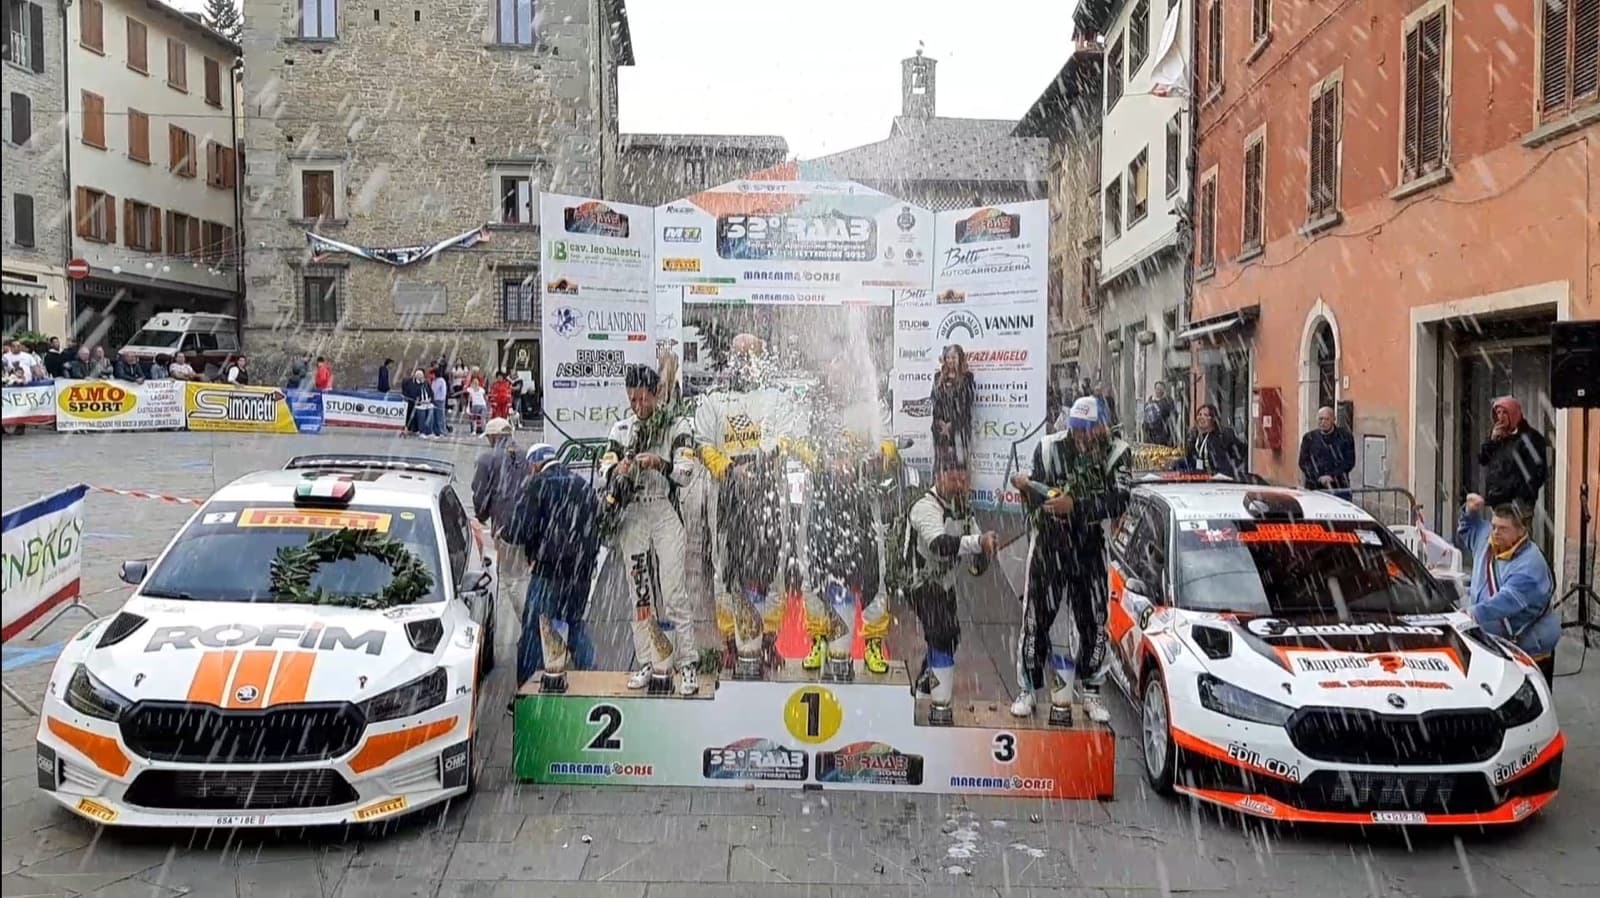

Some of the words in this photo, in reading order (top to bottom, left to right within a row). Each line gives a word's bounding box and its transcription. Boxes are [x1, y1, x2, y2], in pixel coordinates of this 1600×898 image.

[590, 244, 605, 254] leo
[940, 264, 1032, 277] AUTOCARROZZERIA
[587, 310, 647, 332] CALANDRINI
[984, 314, 1034, 331] VANNINI
[576, 349, 625, 362] BRUSORI
[988, 350, 1028, 361] ANGELO
[68, 386, 126, 401] AMO
[973, 381, 1028, 391] annerini
[69, 402, 124, 412] SPORT
[188, 390, 278, 421] Simonetti
[325, 400, 365, 412] STUDIO
[367, 405, 405, 417] COLOR
[800, 692, 820, 737] 1
[588, 704, 622, 750] 2
[994, 734, 1016, 761] 3
[749, 751, 804, 768] RAAB
[1228, 744, 1262, 769] EDIL
[1265, 758, 1301, 783] CDA
[550, 762, 612, 777] MAREMMA
[613, 760, 655, 776] CORSE
[950, 776, 1011, 790] MAREMMA
[1012, 775, 1055, 791] CORSE
